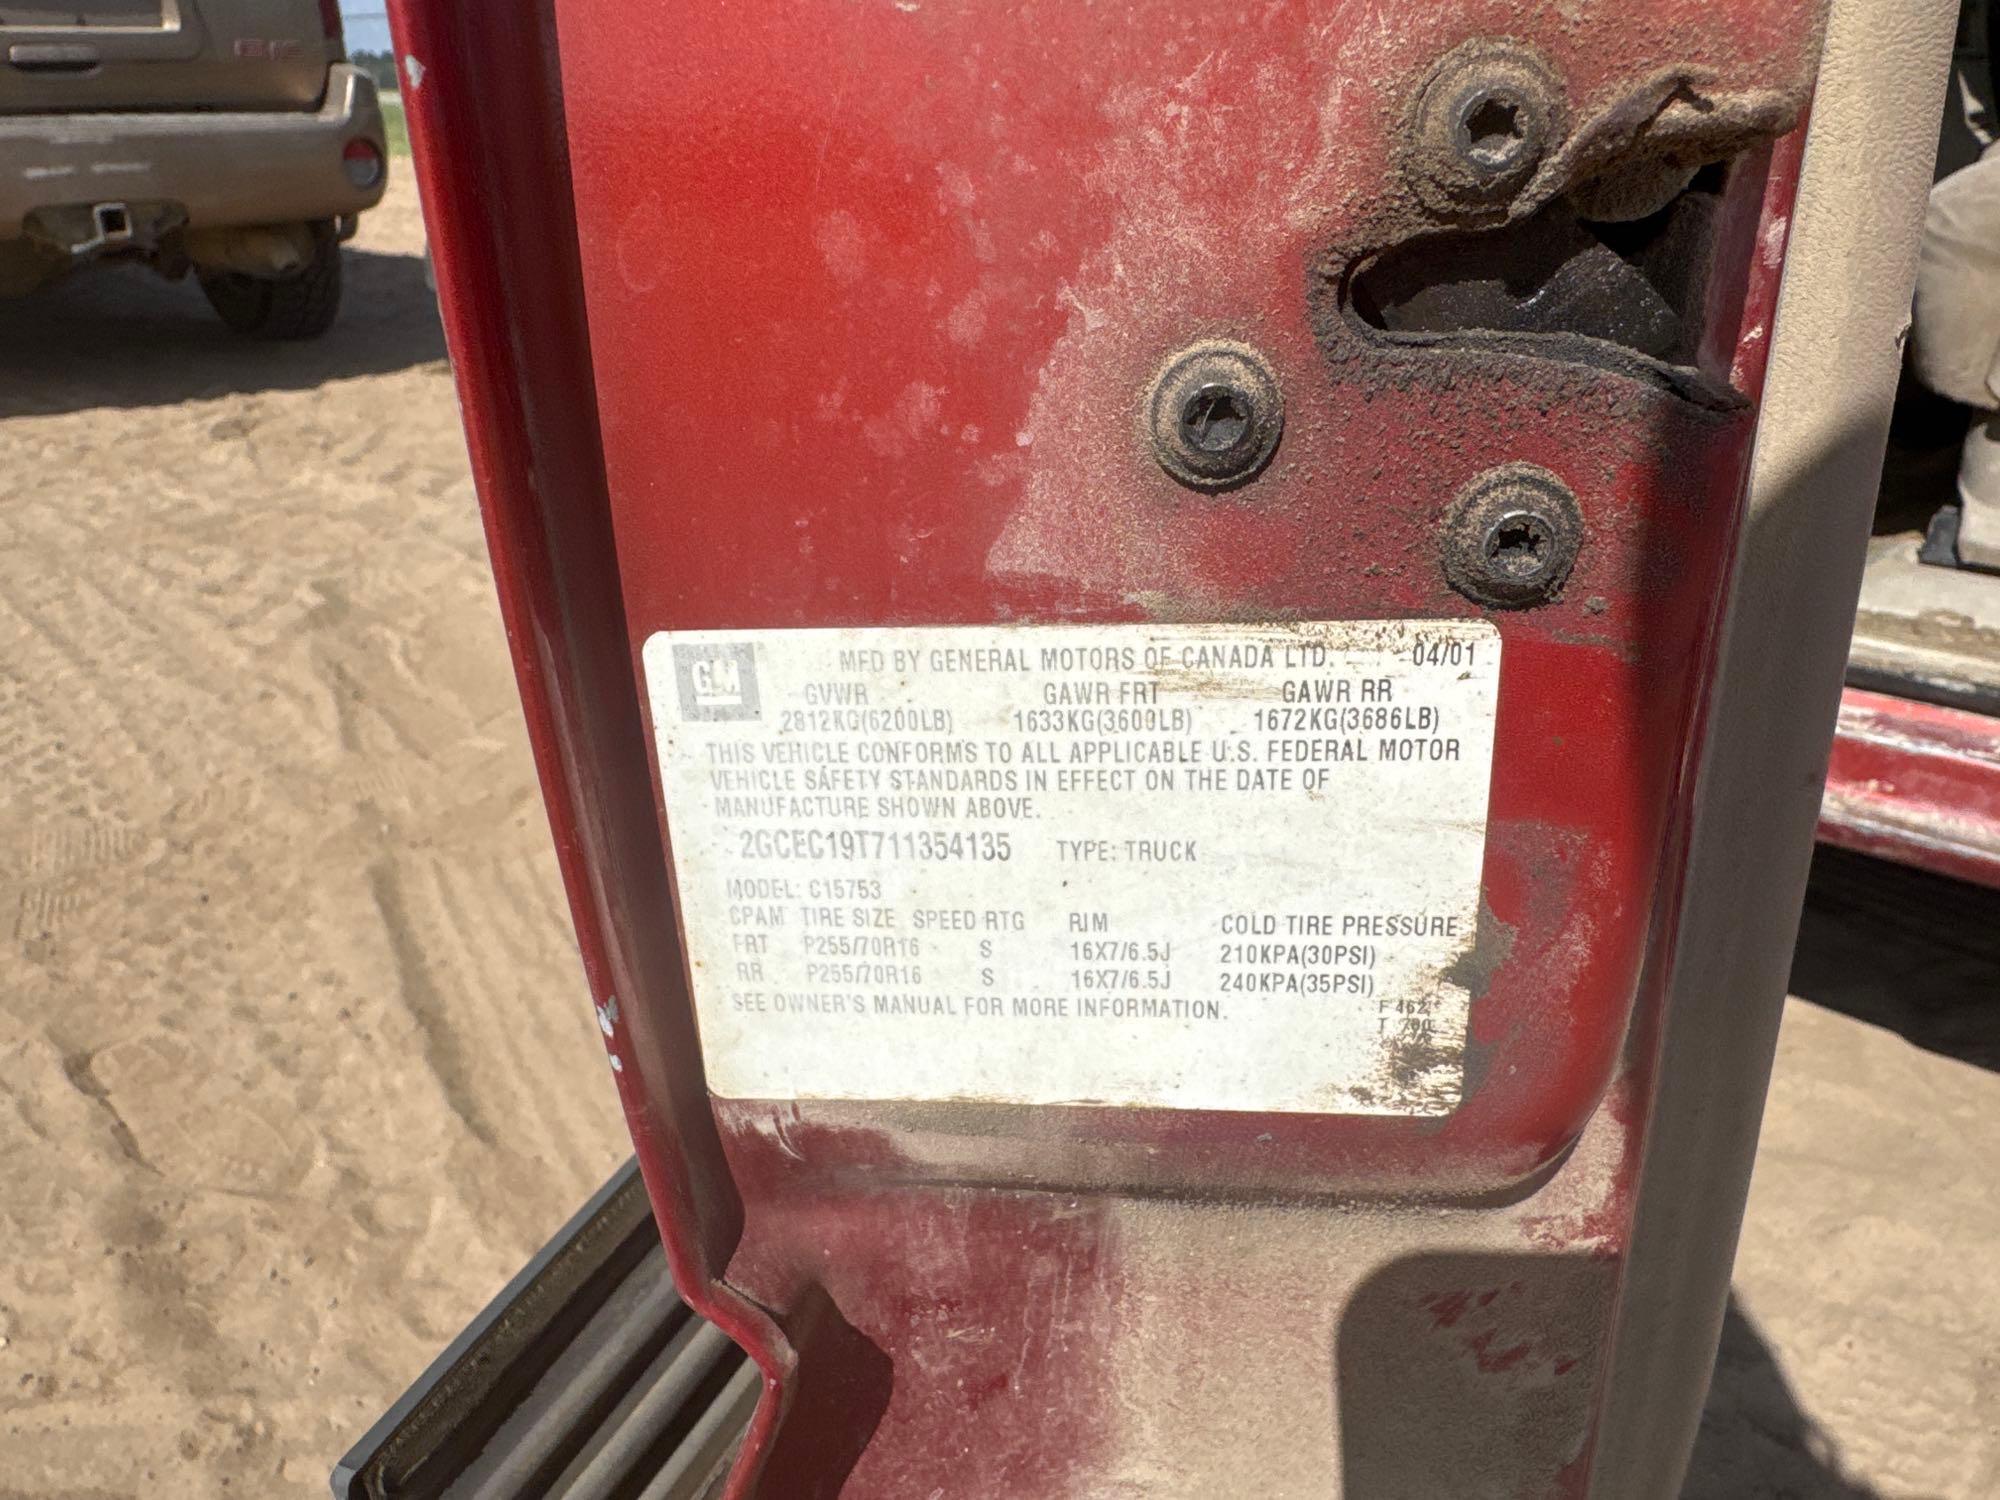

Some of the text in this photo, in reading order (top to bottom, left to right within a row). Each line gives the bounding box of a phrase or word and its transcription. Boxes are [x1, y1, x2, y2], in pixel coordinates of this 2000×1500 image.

[840, 650, 884, 673] MFD
[894, 649, 920, 672] BY
[929, 648, 1031, 673] GENERAL
[1041, 647, 1135, 671] MOTORS
[1144, 646, 1172, 670] OF
[1182, 644, 1274, 669] CANADA
[1412, 640, 1477, 666] 04/01
[804, 682, 870, 706] GVWR
[1044, 680, 1160, 705] GAWR FRT
[1282, 678, 1393, 703] GAWR RR
[781, 709, 953, 735] 2812KG(6200LB)
[1014, 708, 1192, 735] 1633KG(3600LB)
[1254, 706, 1440, 734] 1672KG(3686LB)
[706, 738, 1460, 764] THIS VEHICLE CONFORMS TO ALL APPLICABLE U.S. FEDERAL MOTOR
[710, 768, 1330, 792] VEHICLE SAFETY STANDARDS IN EFFECT ON THE DATE OF
[715, 796, 1041, 819] MANUFACTURE SHOWN ABOVE.
[739, 829, 1012, 862] 2GCEC19T711354135
[1056, 840, 1198, 862] TYPE: TRUCK
[726, 878, 882, 901] MODEL: C15753
[799, 906, 845, 927] TIRE
[852, 907, 896, 929] SIZE
[912, 908, 976, 931] SPEED
[985, 910, 1026, 931] RTG
[1068, 912, 1109, 933] RIM
[1221, 914, 1459, 938] COLD TIRE PRESSURE
[732, 933, 921, 957] FRT P255/70R16
[979, 939, 993, 959] S
[1071, 941, 1171, 962] 16X7/6.5J
[1220, 944, 1376, 969] 210KPA(30PSI)
[736, 962, 923, 985] RR P255/70R16
[981, 967, 996, 987] S
[1071, 970, 1171, 990] 16X7/6.5J
[1219, 973, 1374, 998] 240KPA(35PSI)
[731, 993, 1228, 1020] SEE OWNER'S MANUAL FOR MORE INFORMATION.
